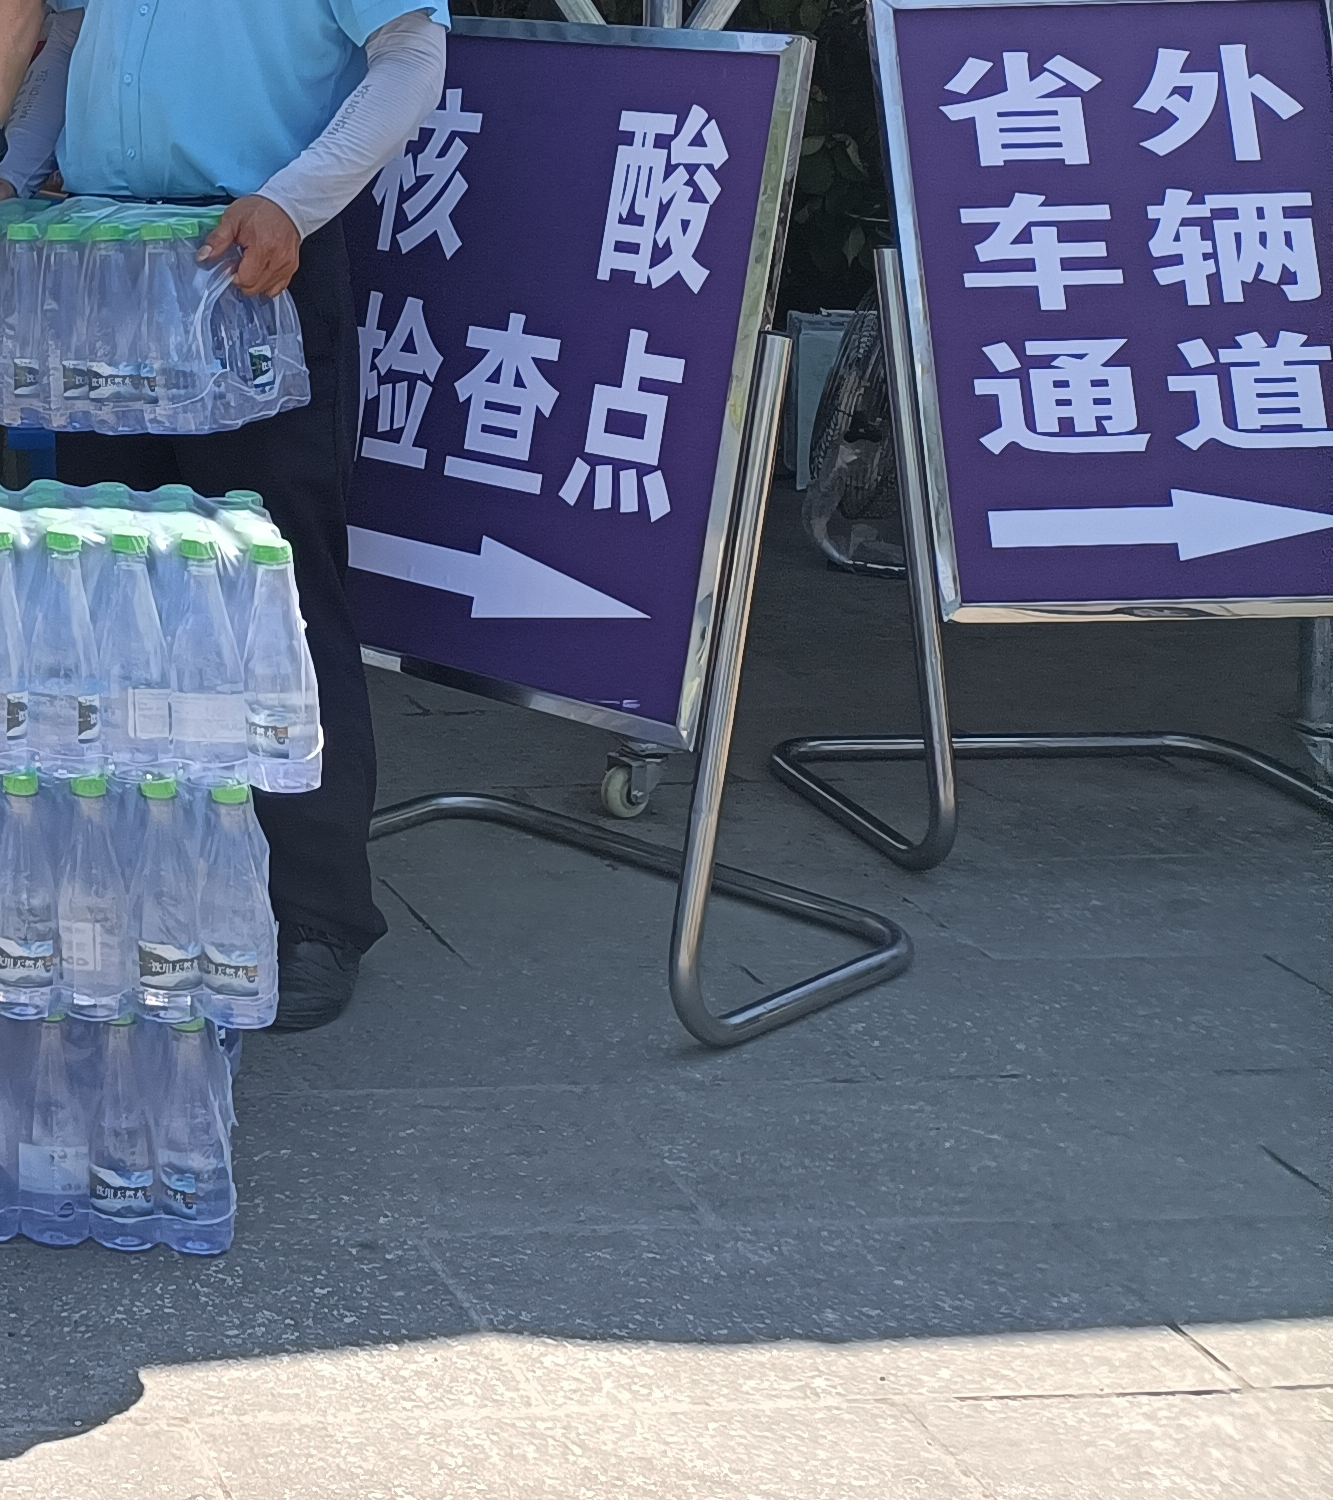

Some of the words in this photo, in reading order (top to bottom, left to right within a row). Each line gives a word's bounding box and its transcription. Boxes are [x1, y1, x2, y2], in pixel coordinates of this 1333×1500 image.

[939, 43, 1304, 167] 省外
[372, 88, 729, 294] 核酸
[960, 189, 1322, 311] 车辆
[355, 290, 686, 522] 检查点
[974, 330, 1333, 455] 通道
[96, 1184, 145, 1201] 饮用天然水
